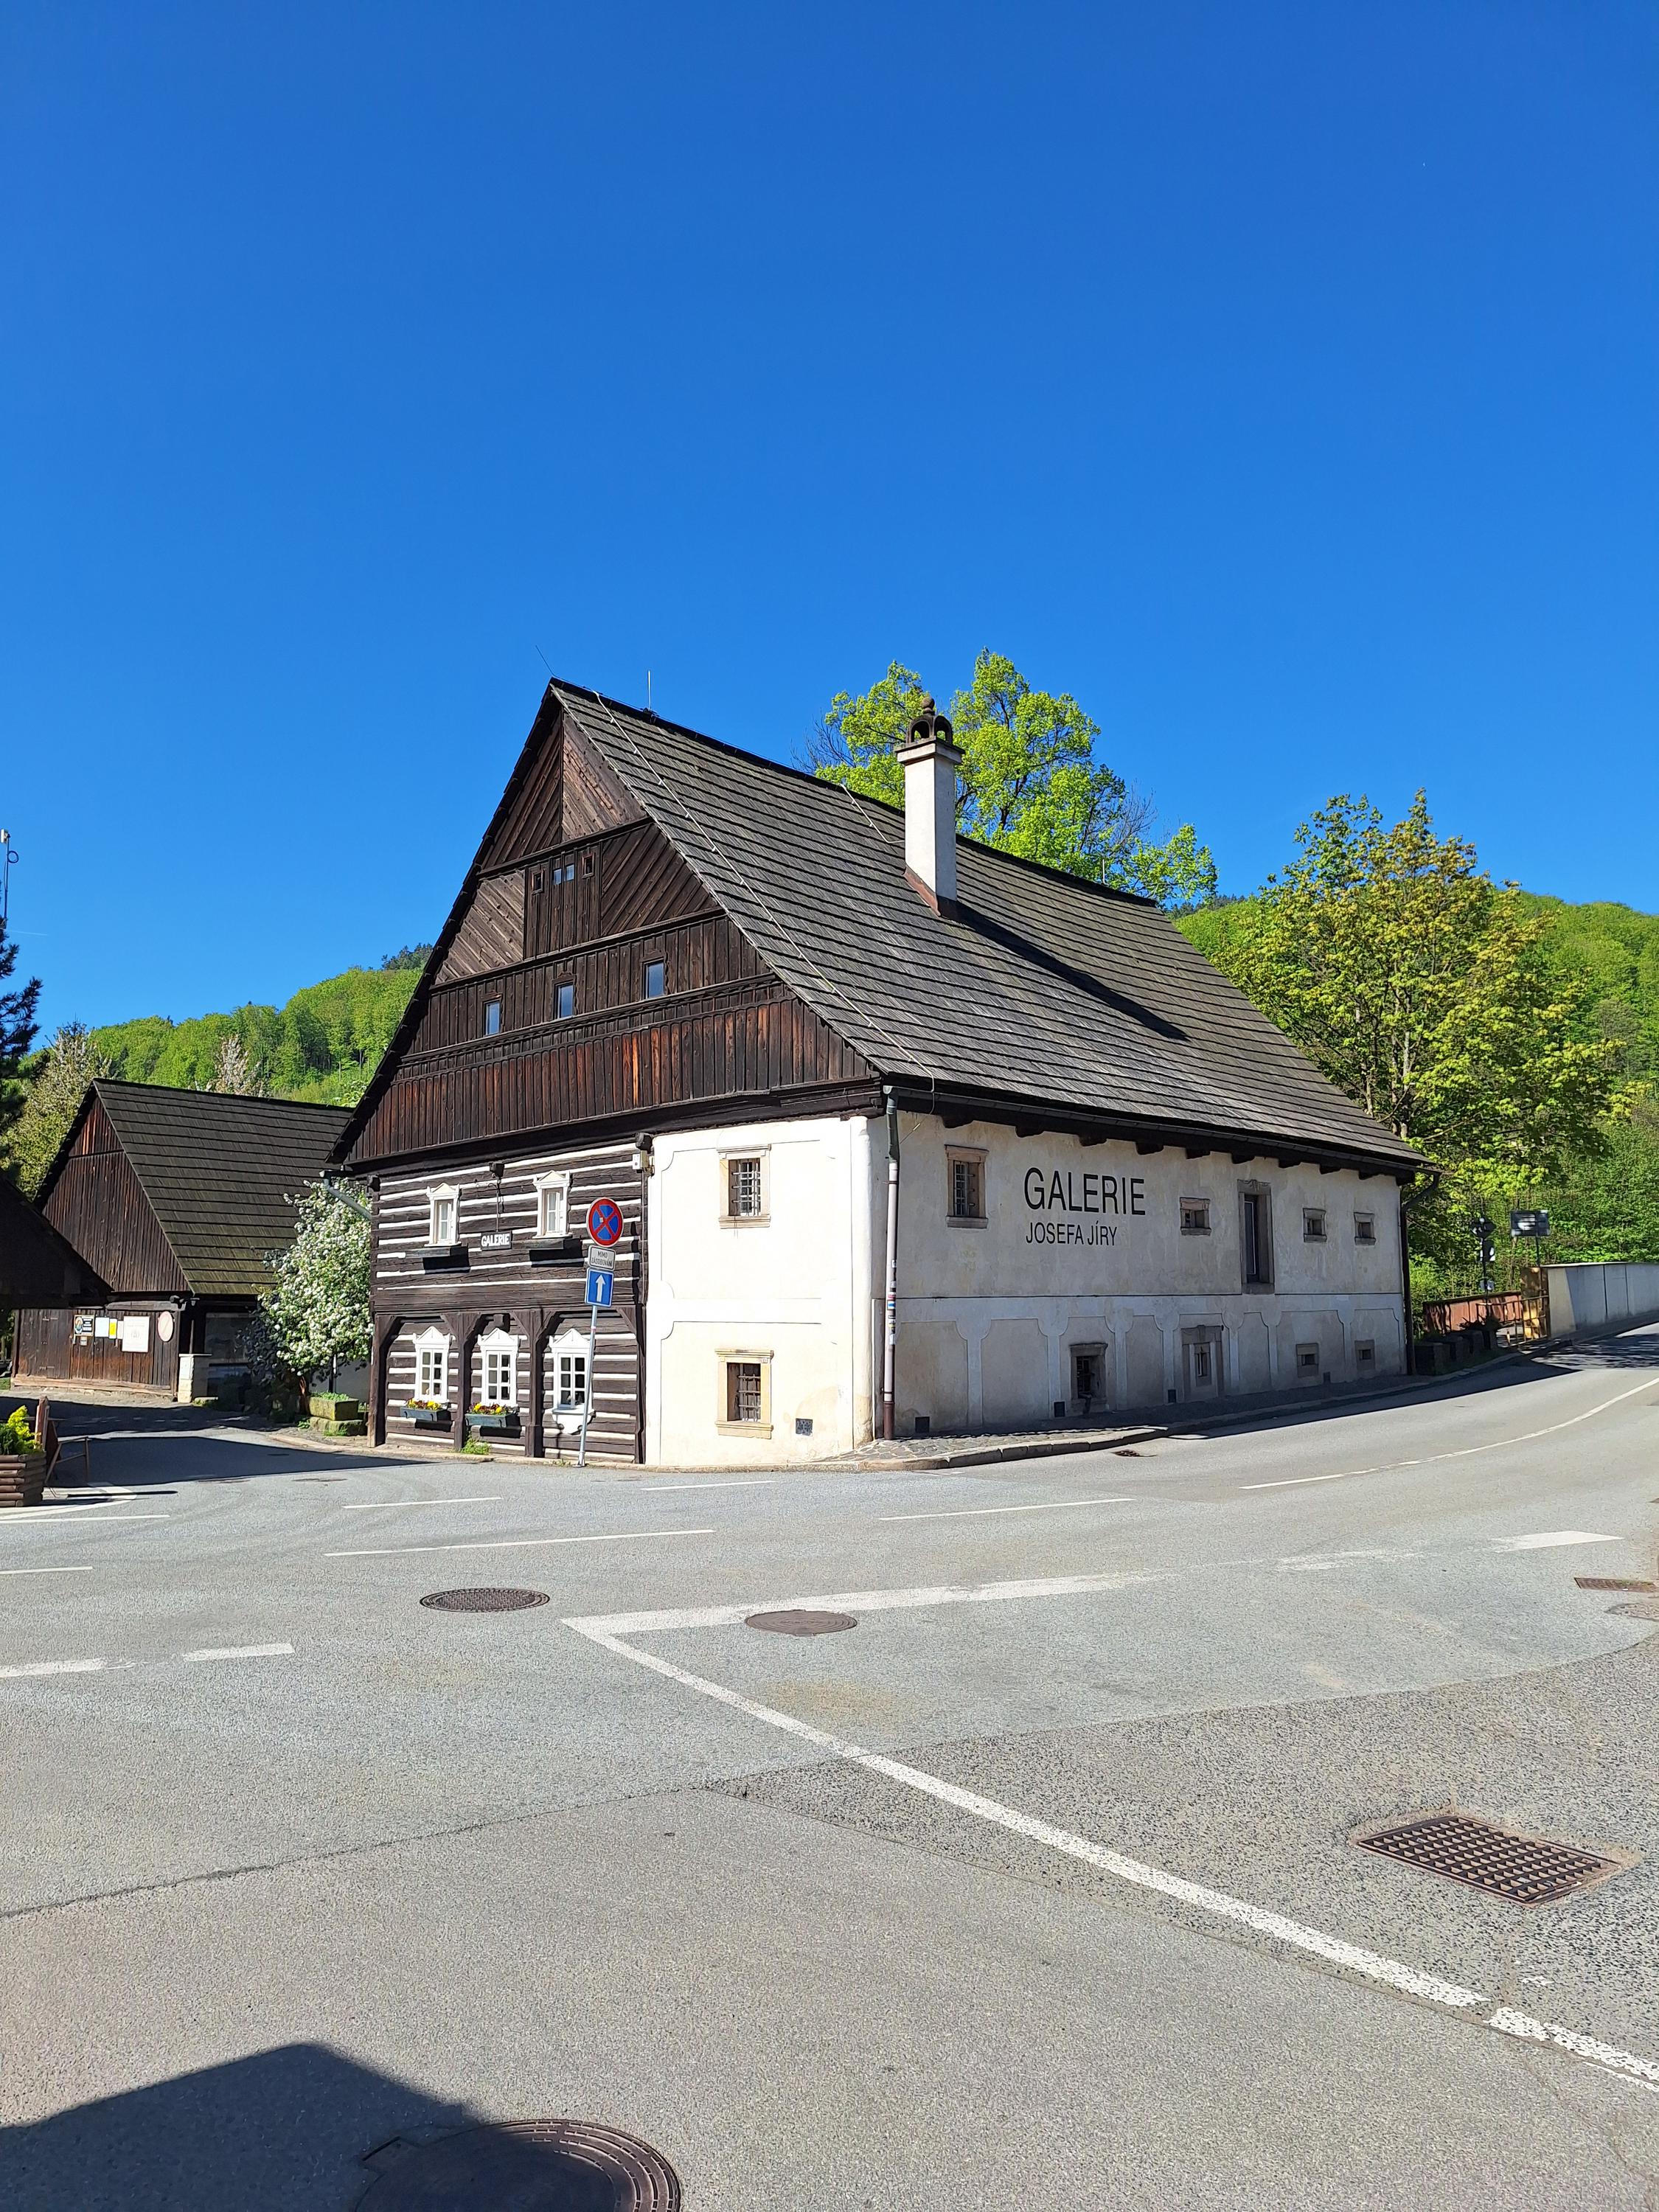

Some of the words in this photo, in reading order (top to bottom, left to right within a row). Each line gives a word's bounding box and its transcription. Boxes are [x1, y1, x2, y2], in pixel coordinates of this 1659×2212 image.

[1024, 1167, 1146, 1215] GALERIE
[481, 1234, 510, 1247] GALERIE
[1026, 1222, 1084, 1245] JOSEFA
[1088, 1220, 1117, 1245] JÍRY
